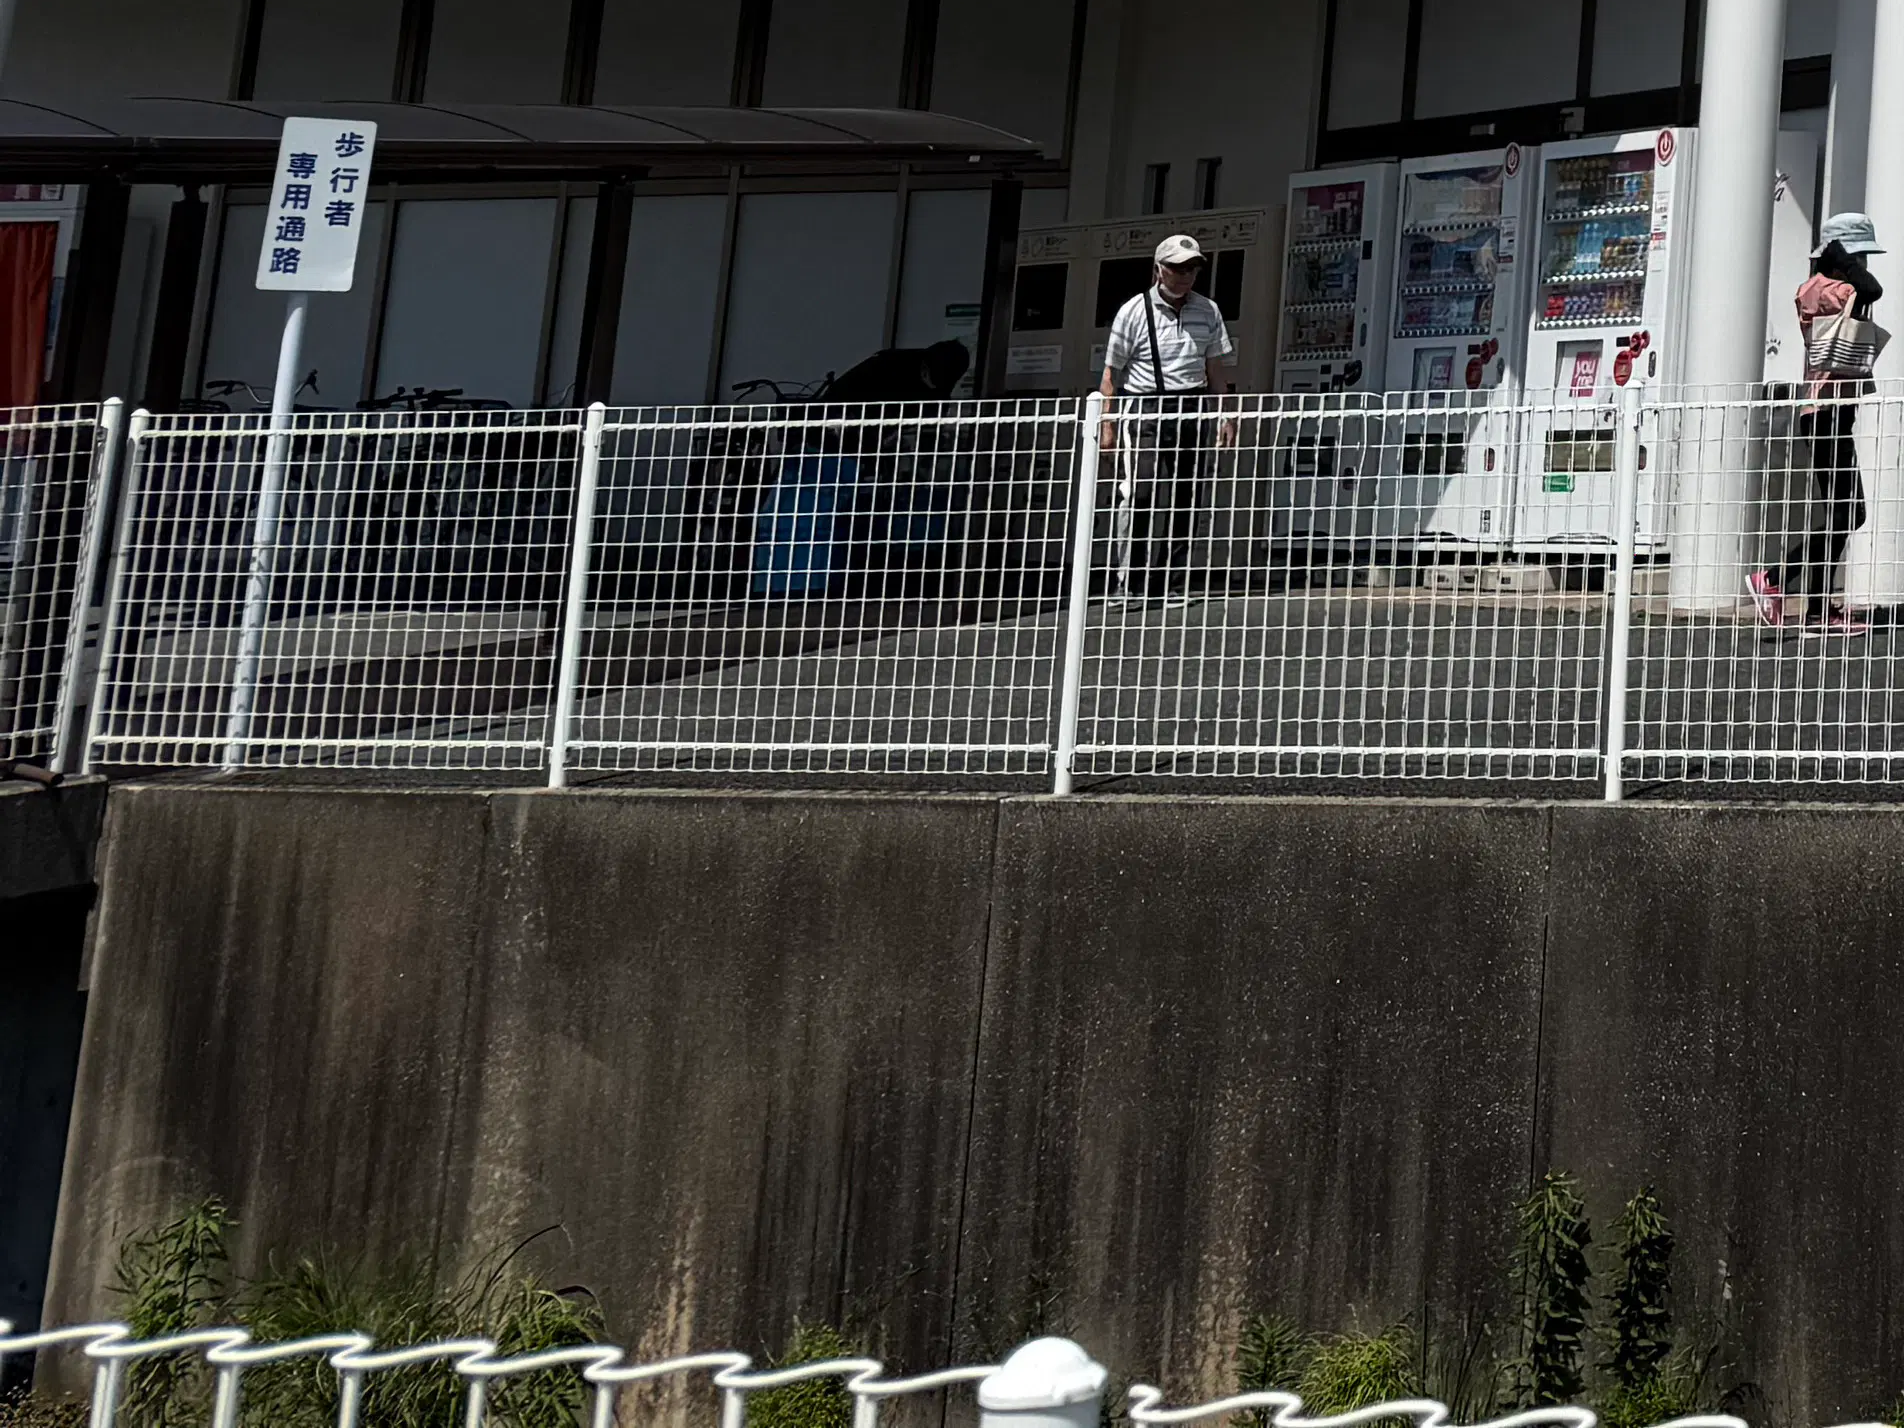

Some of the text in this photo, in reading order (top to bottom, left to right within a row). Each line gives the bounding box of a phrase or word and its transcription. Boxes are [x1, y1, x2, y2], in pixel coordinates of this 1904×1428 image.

[269, 152, 318, 275] 専用通路
[324, 132, 365, 227] 歩行者
[1575, 359, 1596, 380] you
